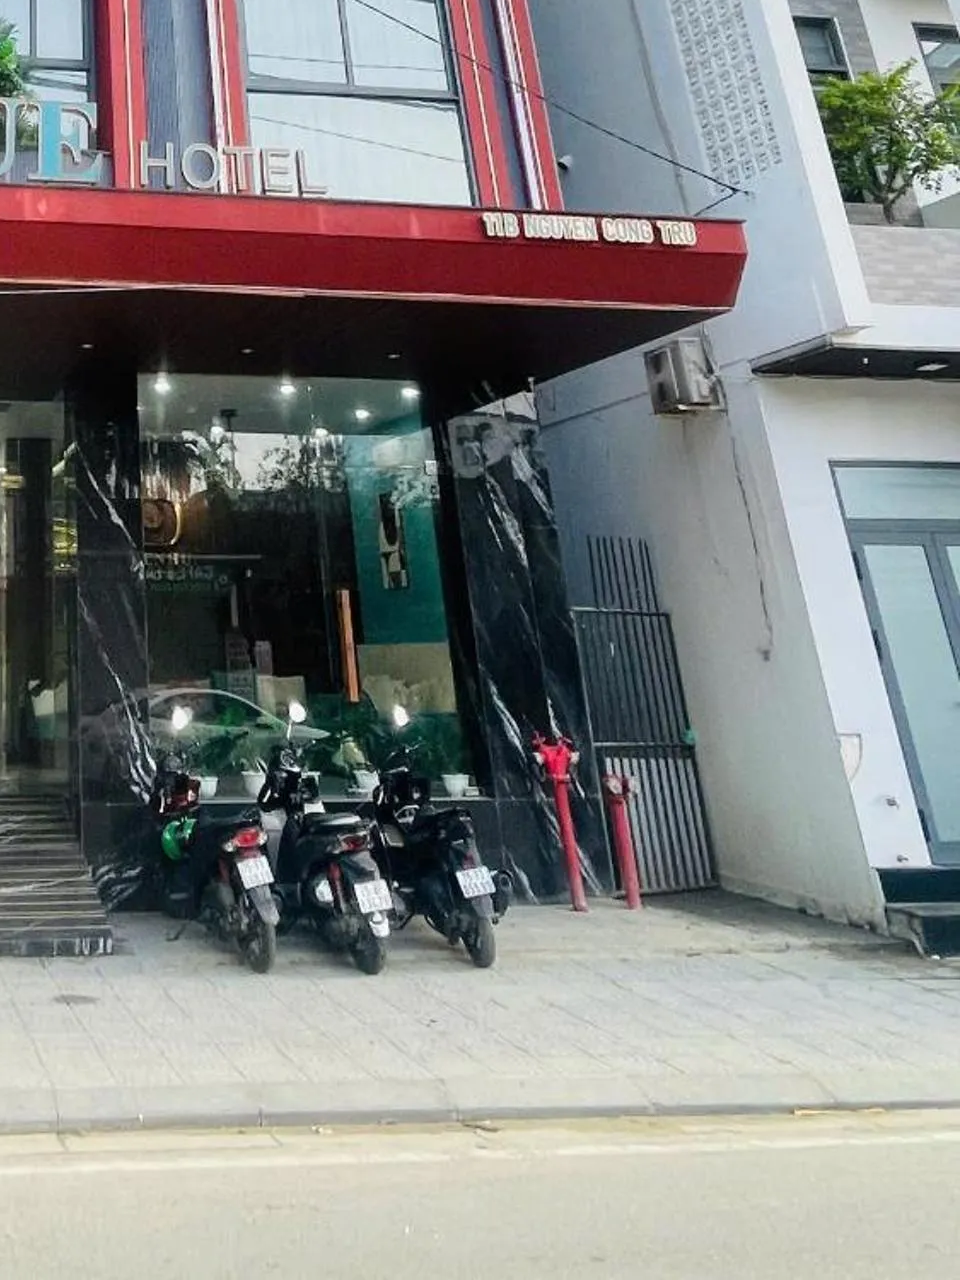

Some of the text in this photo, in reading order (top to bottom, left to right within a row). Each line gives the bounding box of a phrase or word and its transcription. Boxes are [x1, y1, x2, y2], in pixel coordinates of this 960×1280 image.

[140, 140, 329, 196] HOTEL
[524, 214, 598, 240] NGUYEN
[602, 219, 654, 243] CONG
[656, 222, 698, 245] TRU
